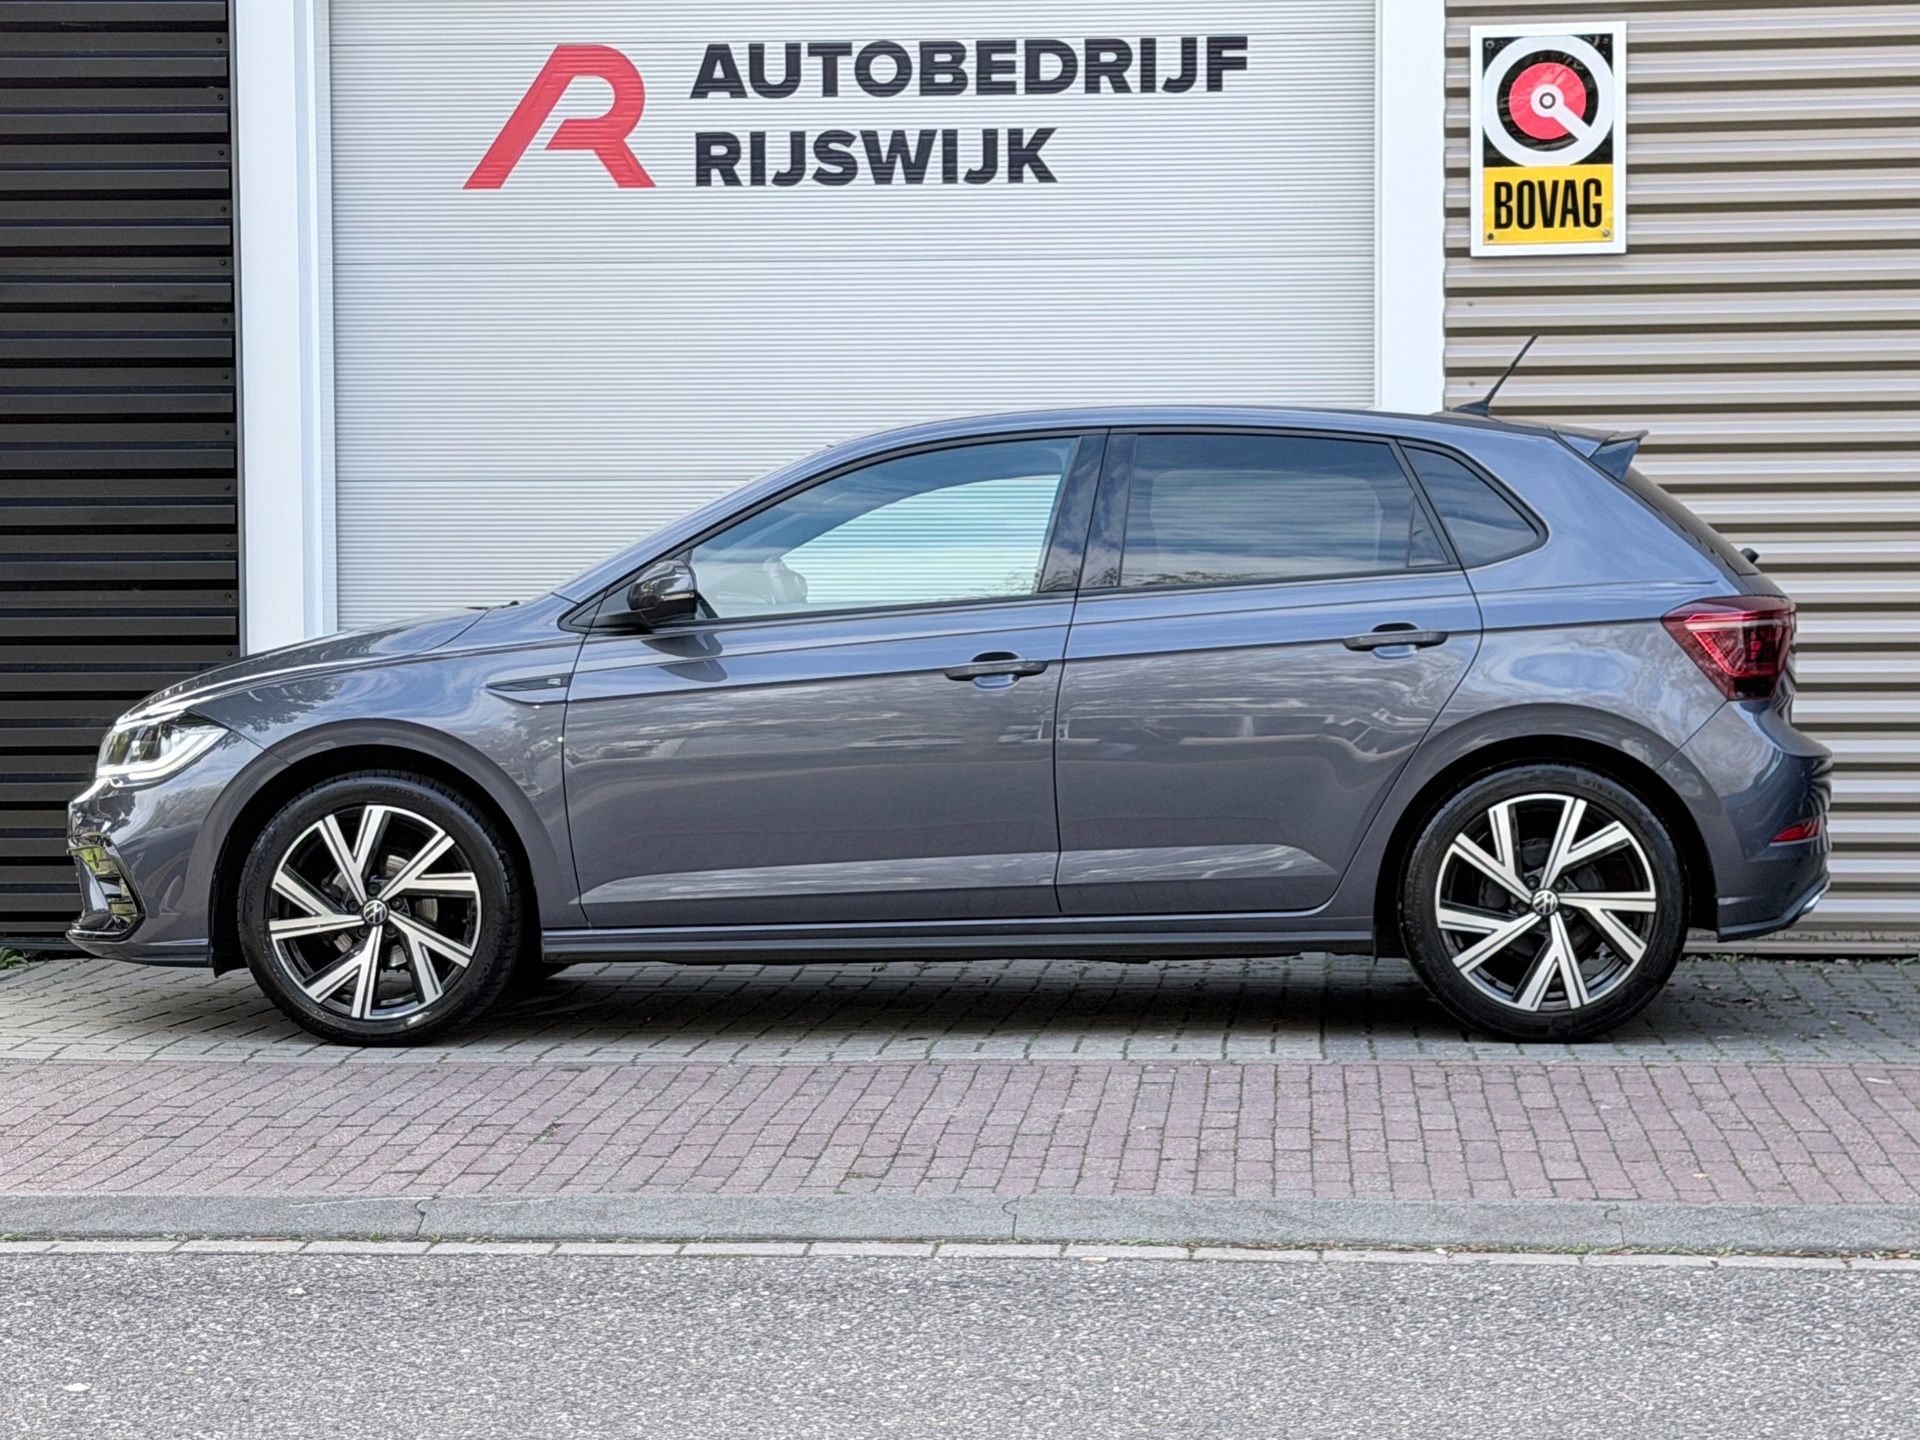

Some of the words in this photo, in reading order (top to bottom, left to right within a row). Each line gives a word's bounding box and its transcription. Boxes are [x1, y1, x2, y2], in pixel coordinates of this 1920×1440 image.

[689, 36, 1248, 99] AUTOBEDRIJF
[695, 127, 1058, 187] RIJSWIJK
[1494, 178, 1602, 230] BOVAG
